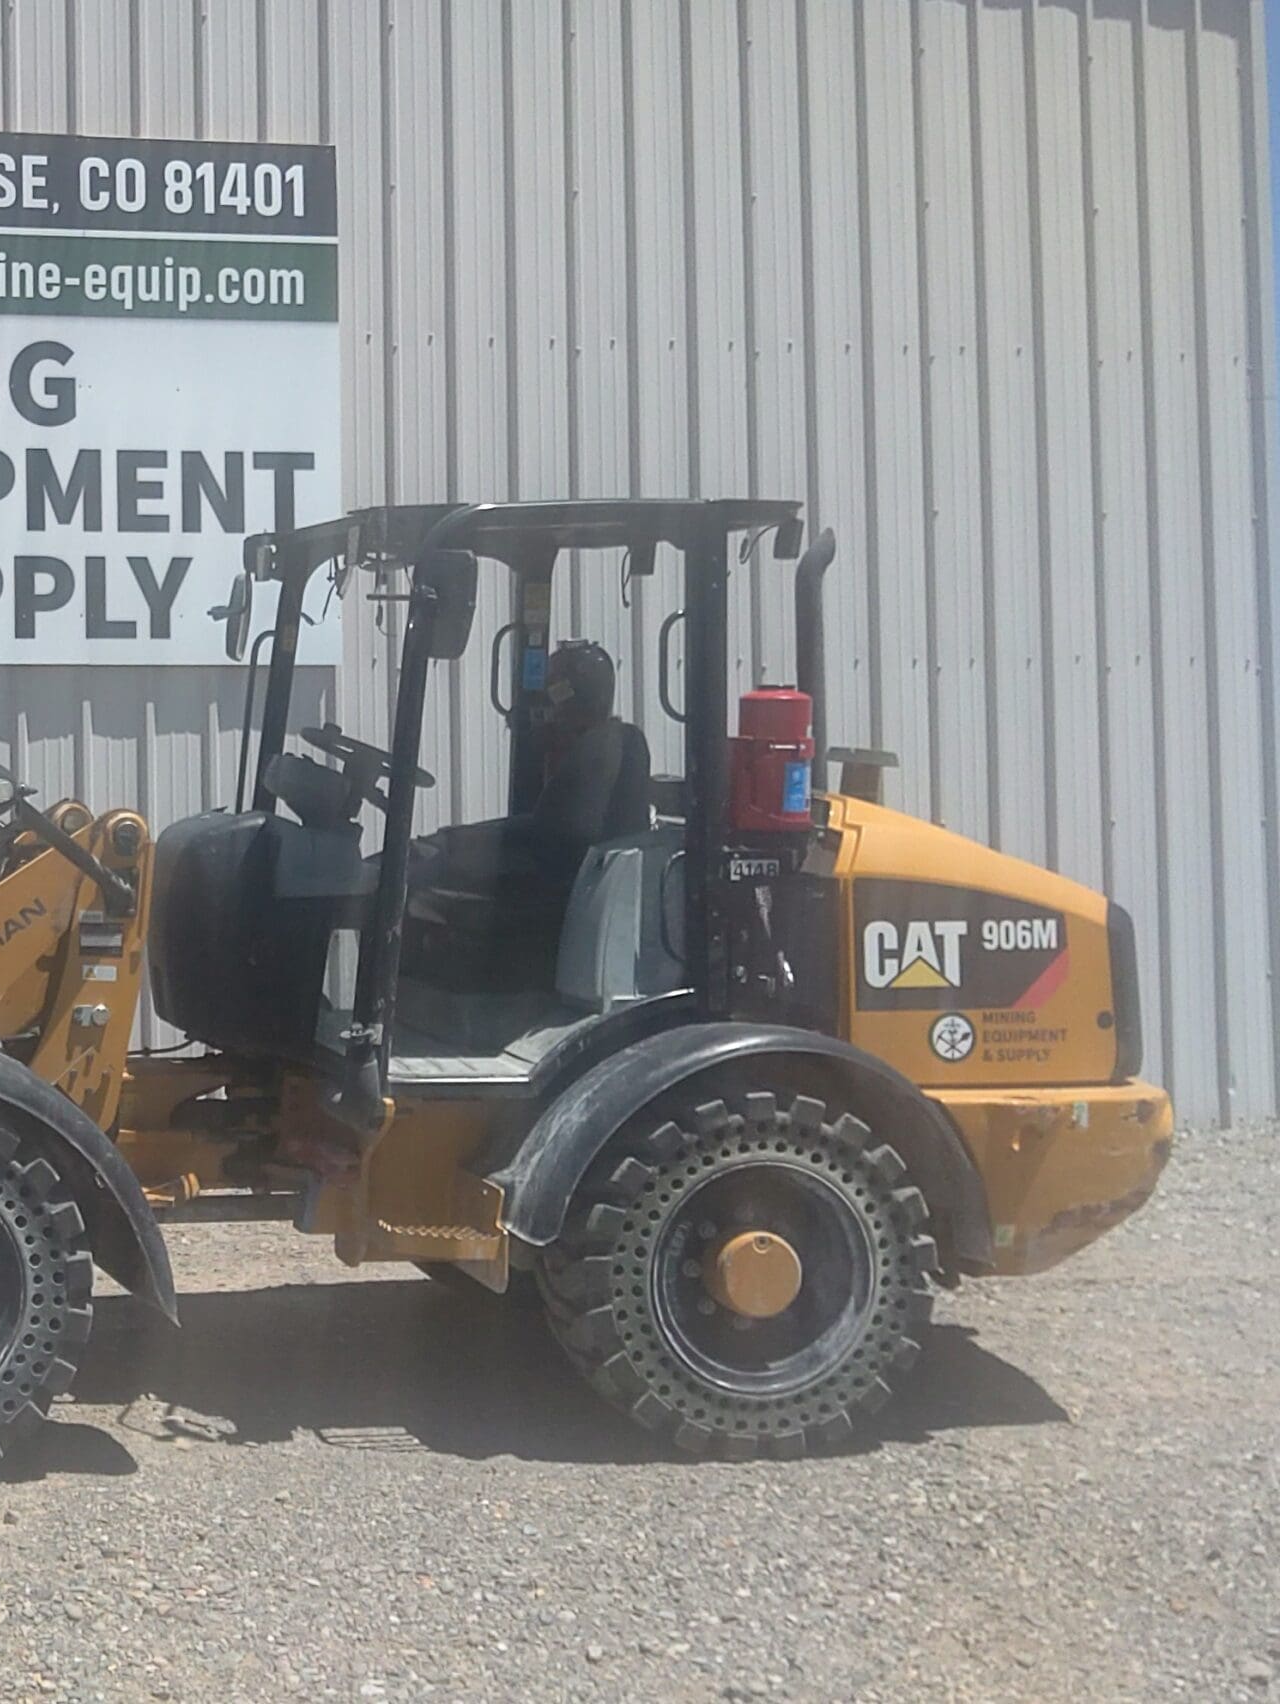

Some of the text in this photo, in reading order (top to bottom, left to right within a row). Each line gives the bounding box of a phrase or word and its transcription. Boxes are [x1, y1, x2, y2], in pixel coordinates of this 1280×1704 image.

[79, 156, 146, 213] CO
[164, 161, 305, 217] 81401
[982, 919, 1058, 950] 906M
[863, 920, 968, 988] CAT
[982, 1011, 1036, 1024] MINING
[982, 1028, 1067, 1042] EQUIPMENT
[997, 1048, 1051, 1062] SUPPLY
